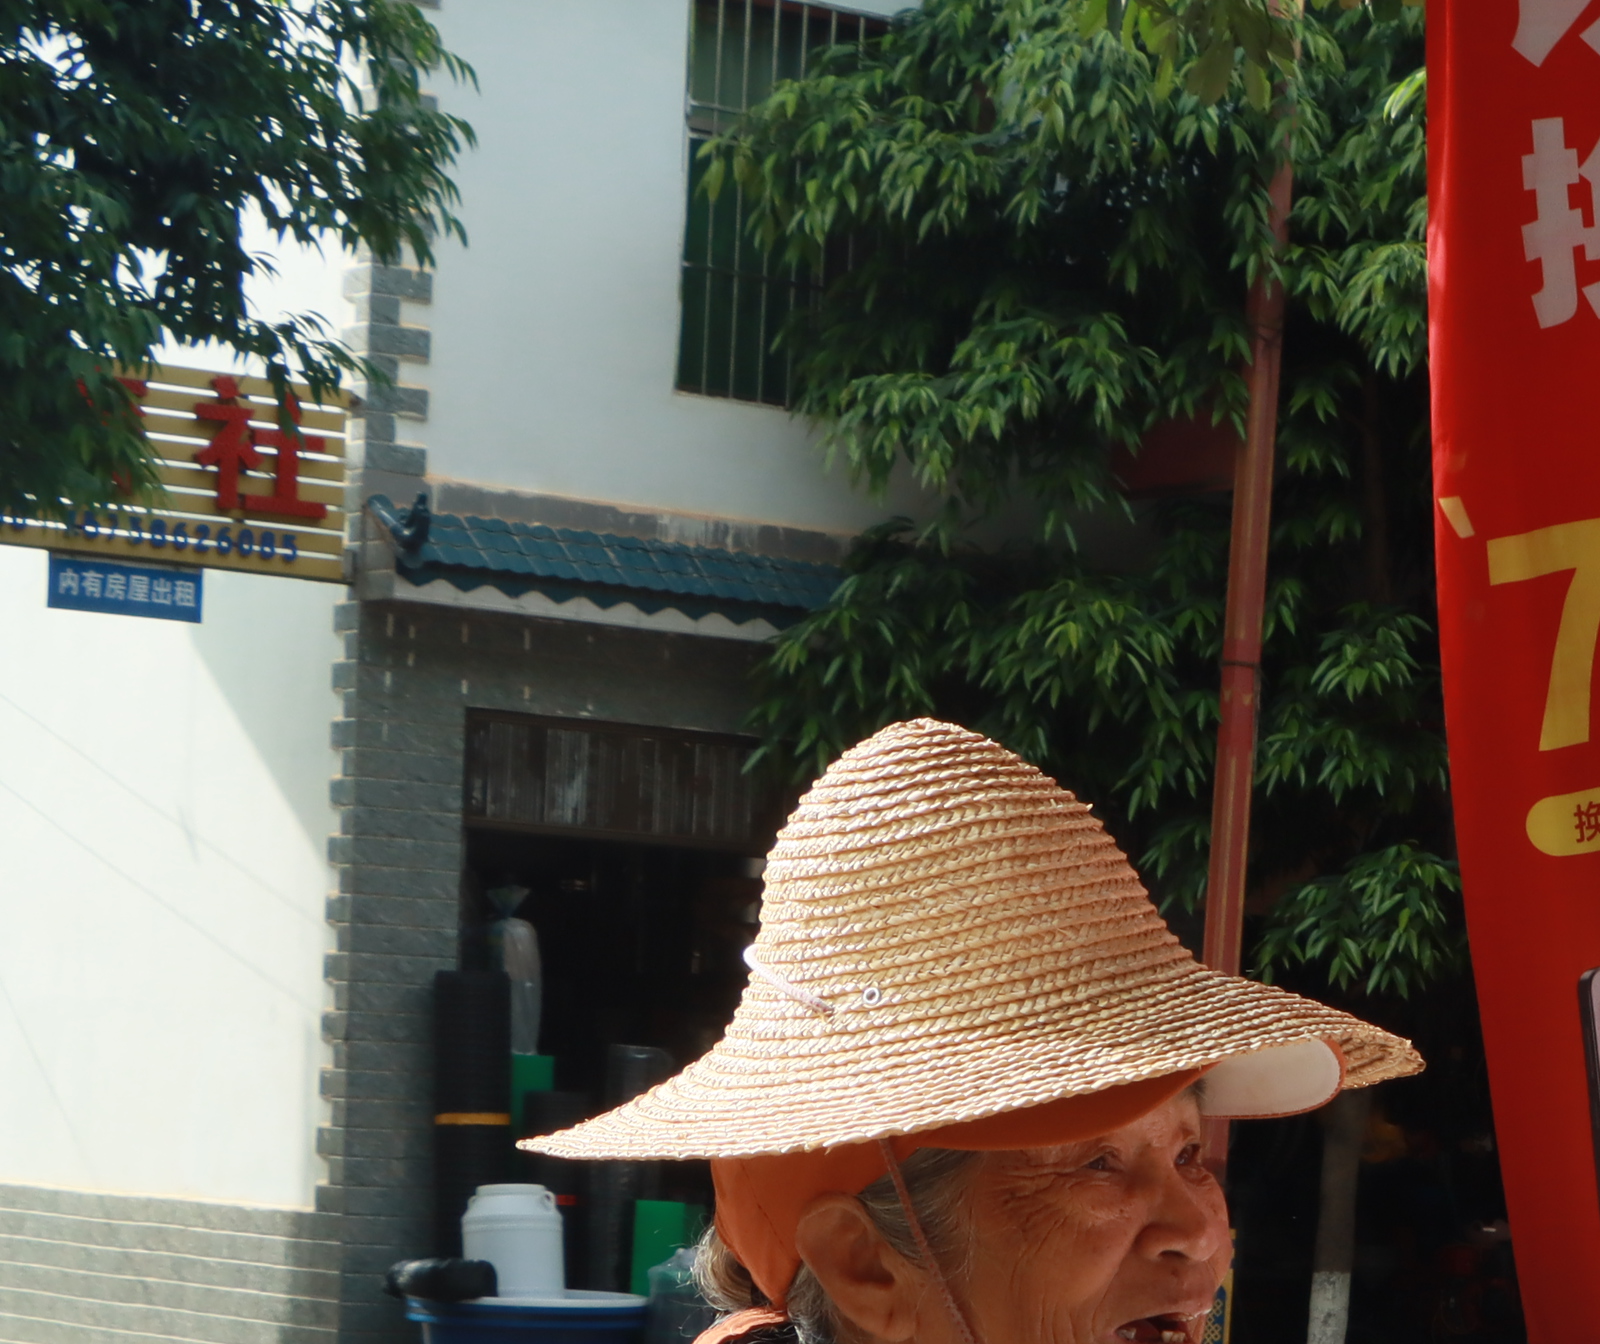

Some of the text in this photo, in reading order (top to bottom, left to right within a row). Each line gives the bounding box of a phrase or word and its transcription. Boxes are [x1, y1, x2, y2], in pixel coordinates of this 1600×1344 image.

[58, 569, 196, 607] 内有房屋出租
